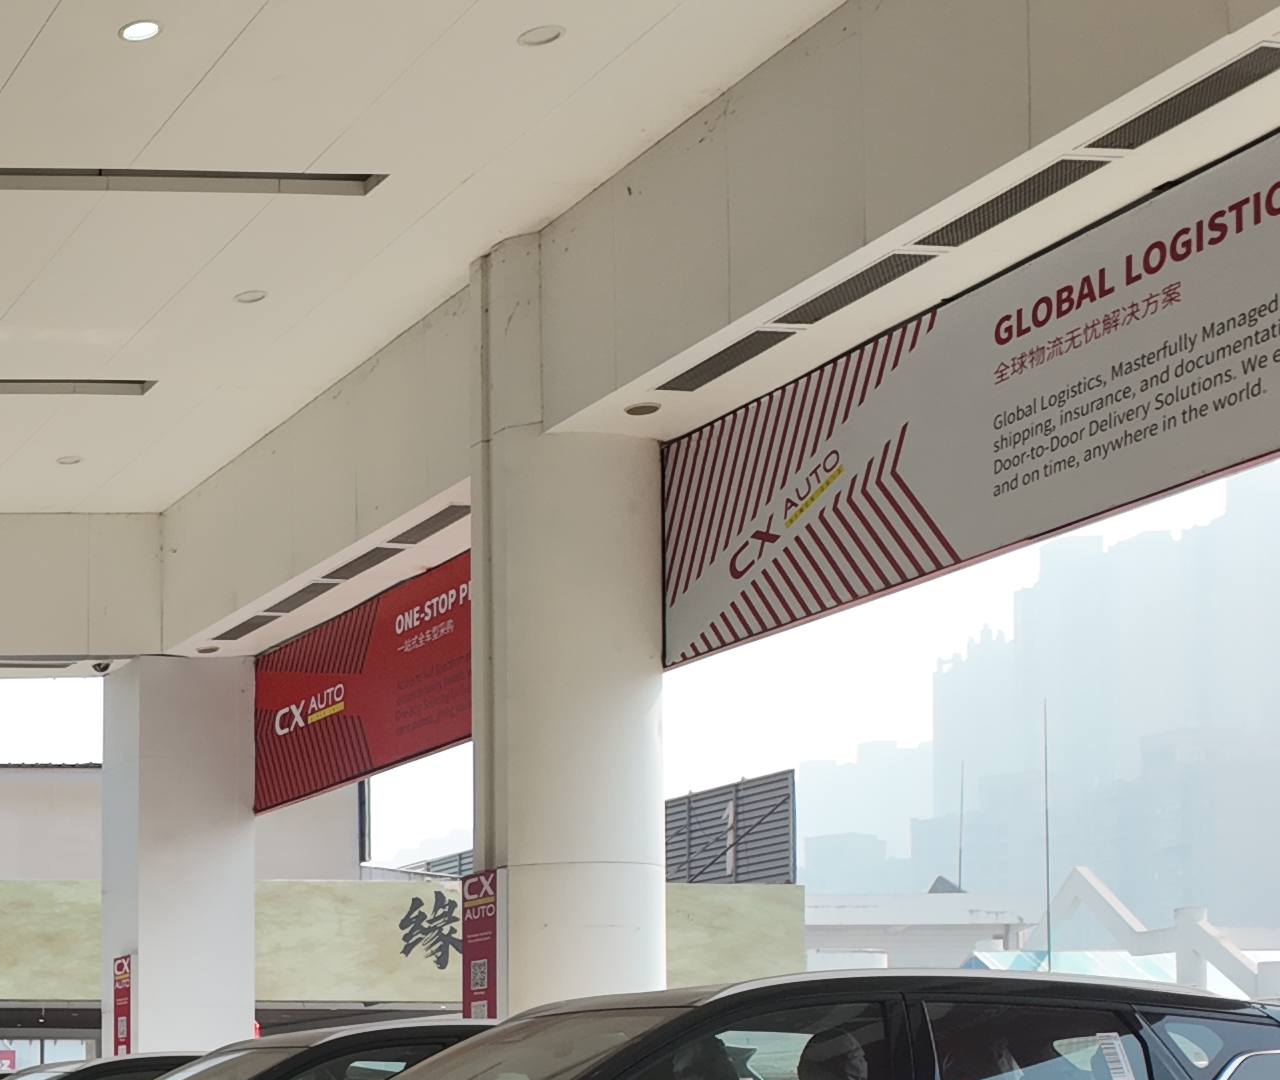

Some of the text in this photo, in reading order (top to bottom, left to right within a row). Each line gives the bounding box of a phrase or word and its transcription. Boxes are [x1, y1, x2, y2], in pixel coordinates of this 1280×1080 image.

[993, 281, 1182, 386] 全球物流无忧解决方案
[994, 267, 1115, 346] GLOBAL
[993, 293, 1279, 430] Global Logistics, Masterfully Managed
[993, 422, 1056, 453] shipping,
[1060, 386, 1136, 426] insurance,
[1140, 364, 1170, 393] and
[993, 428, 1086, 475] Door-to-Door
[1089, 401, 1151, 438] Delivery
[1154, 367, 1237, 411] Solutions.
[1241, 353, 1268, 375] We
[993, 377, 1267, 497] and on time, anywhere in the world.
[729, 449, 840, 580] CX AUTO
[395, 588, 457, 635] ONE-STOP
[275, 699, 306, 736] CX
[307, 683, 345, 715] AUTO
[463, 873, 495, 901] CX
[464, 904, 496, 921] AUTO
[114, 958, 130, 976] CX
[398, 890, 463, 970] 缘
